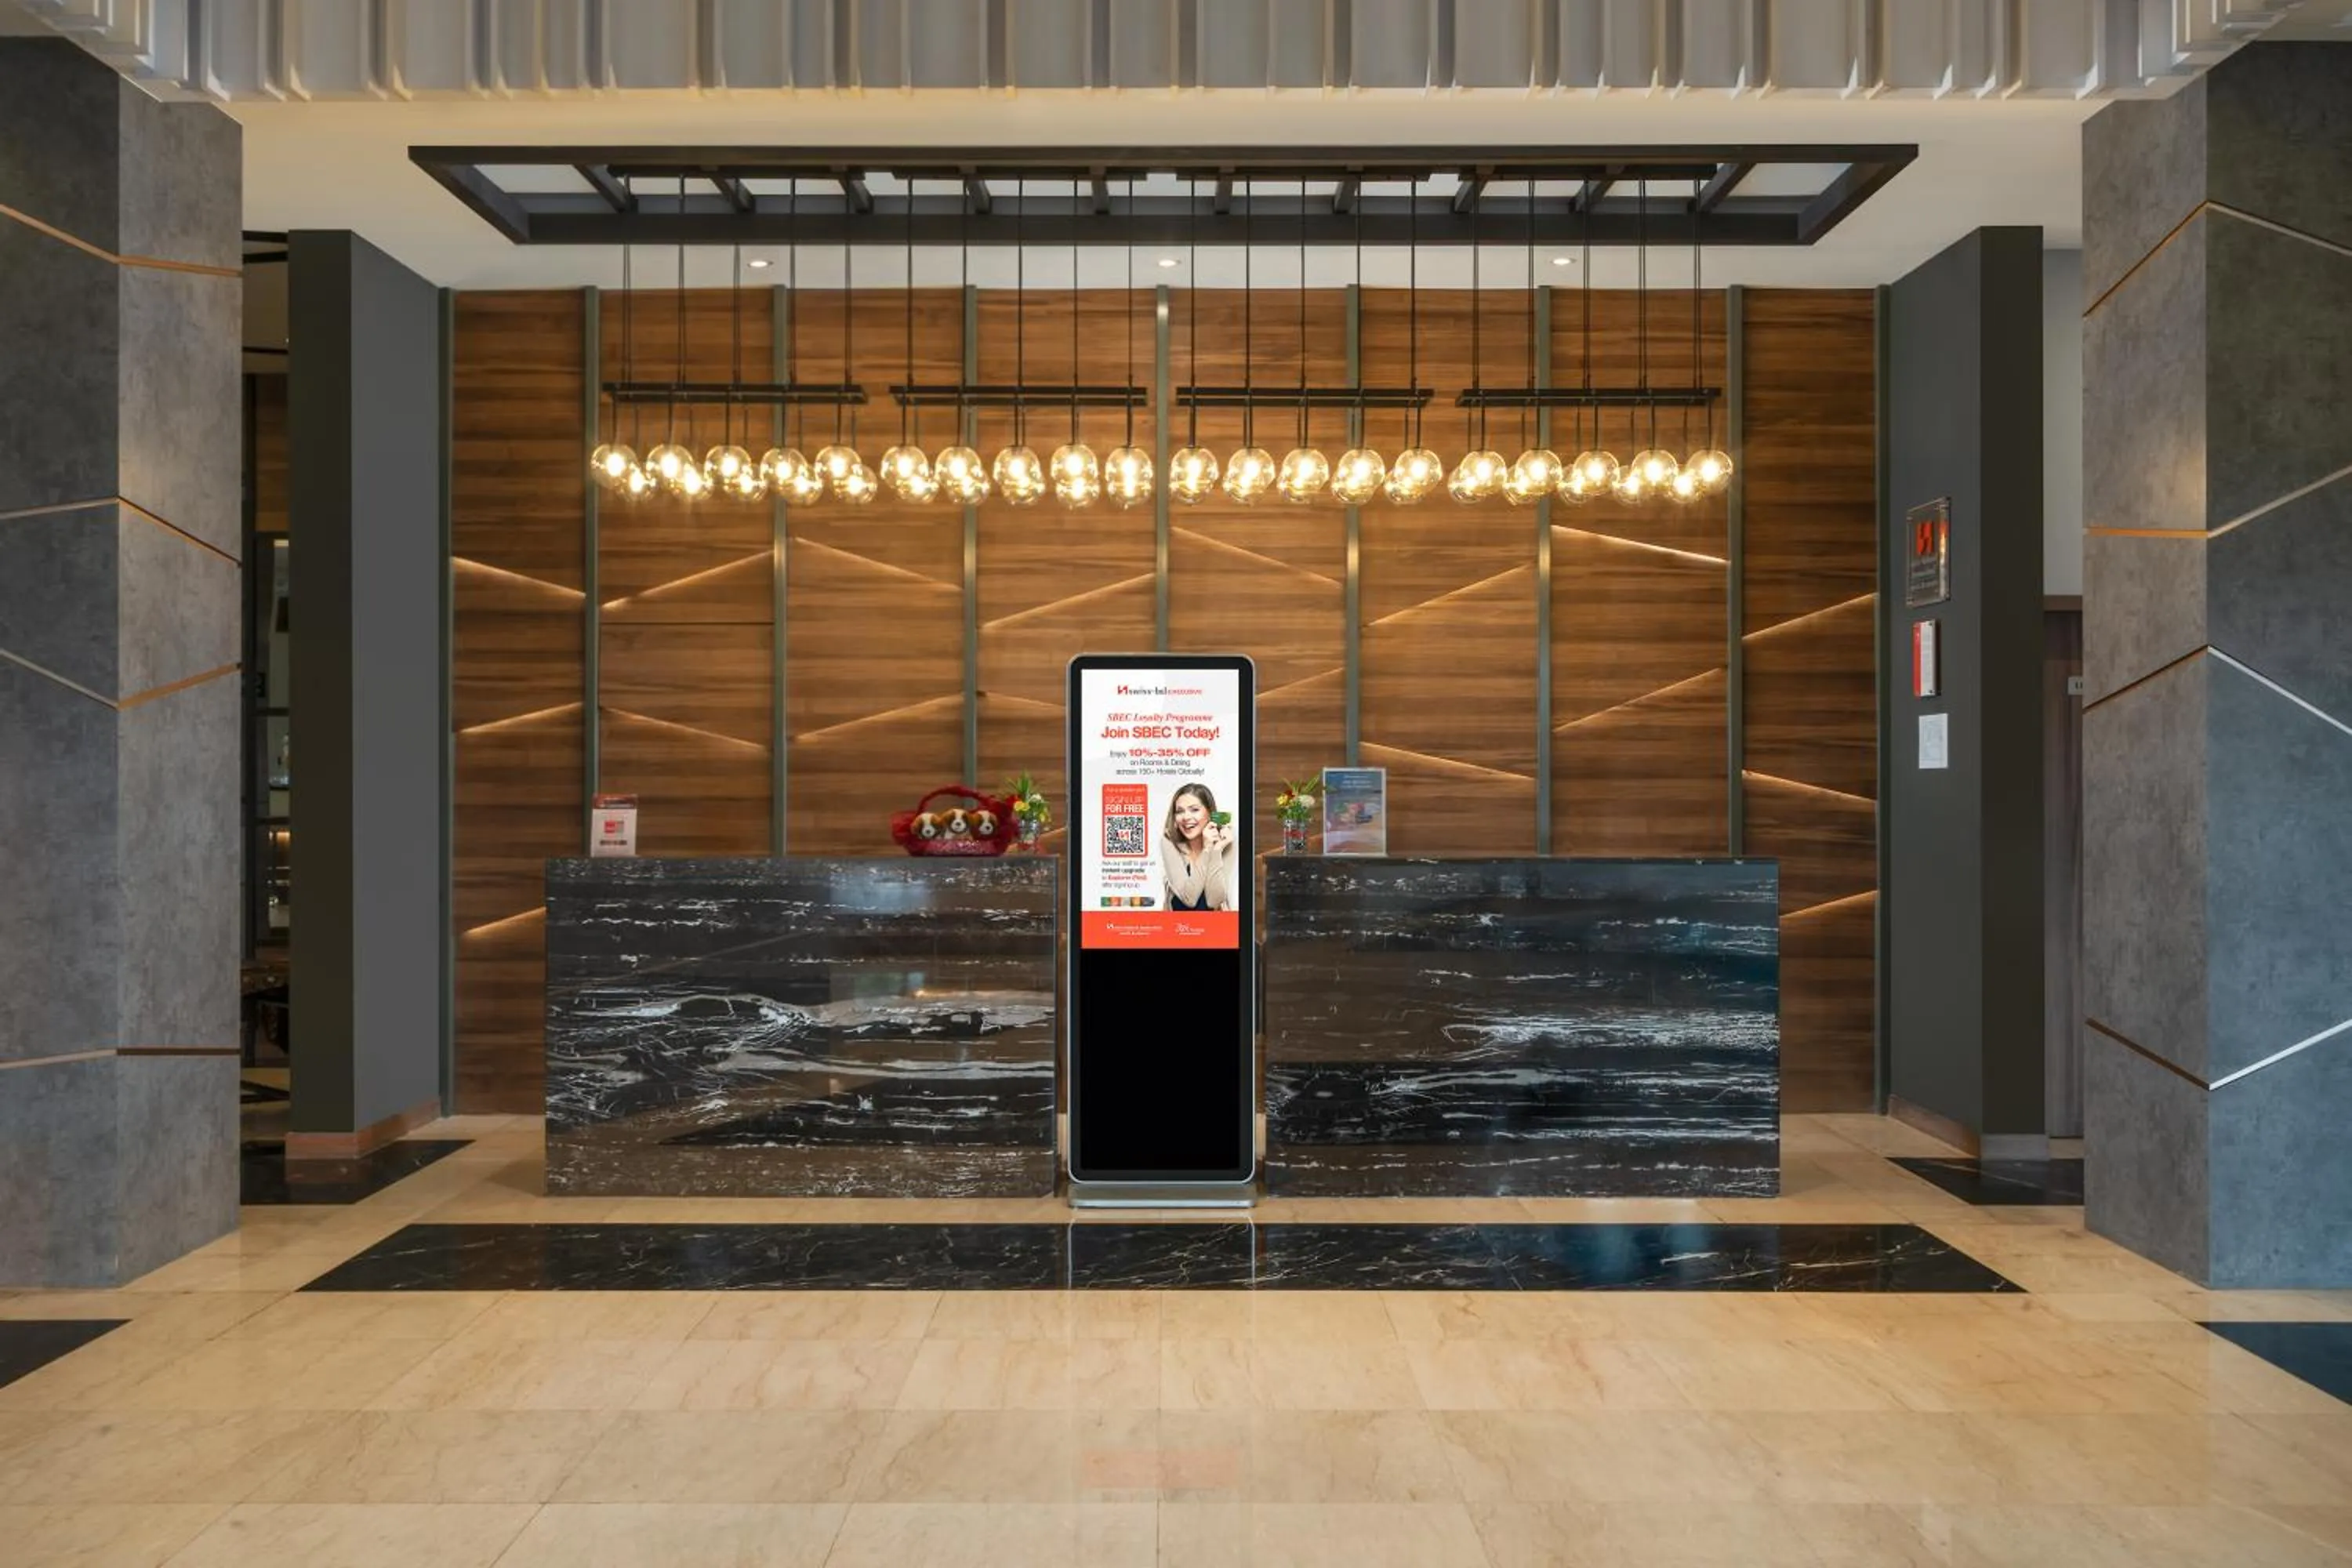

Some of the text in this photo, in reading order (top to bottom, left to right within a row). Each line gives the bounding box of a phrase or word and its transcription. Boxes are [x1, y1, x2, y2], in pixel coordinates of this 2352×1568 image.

[1102, 726, 1220, 741] Join SBEC Today!
[1186, 748, 1211, 757] OFF
[1105, 804, 1144, 813] FOR FREE
